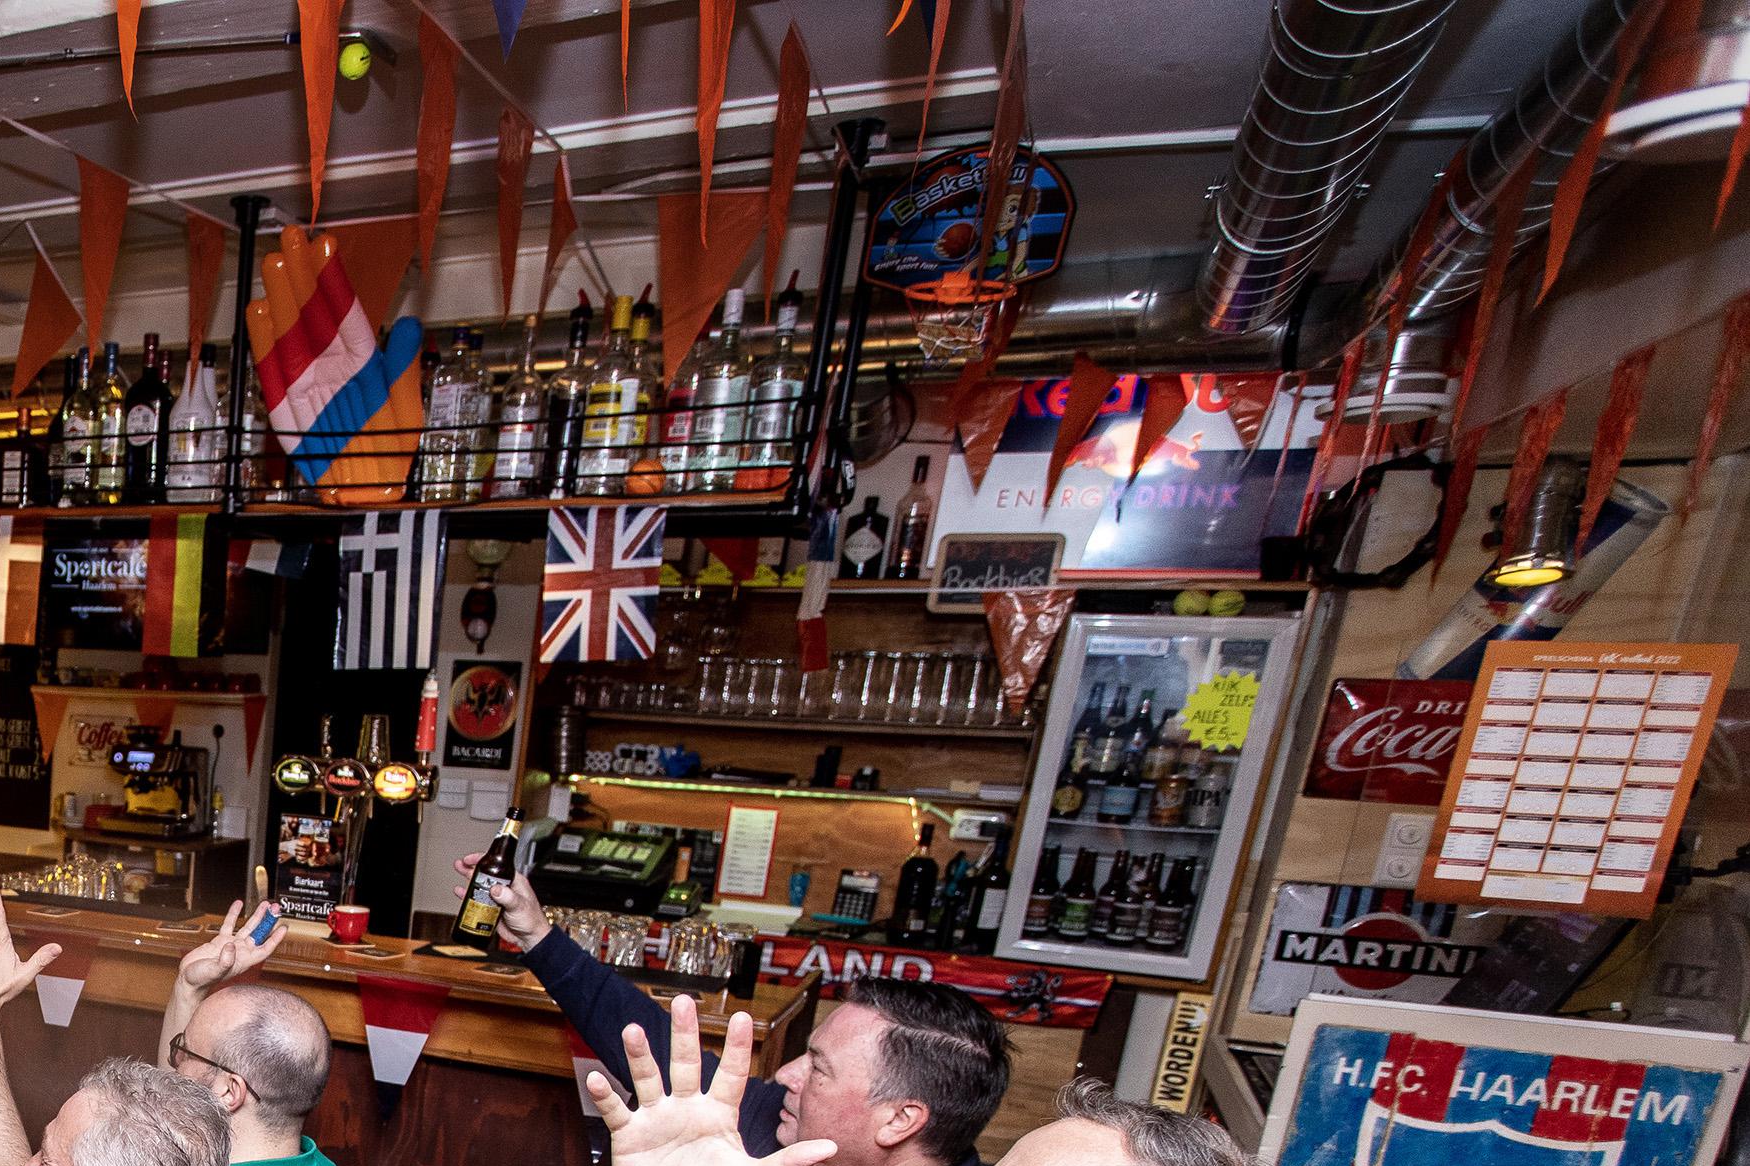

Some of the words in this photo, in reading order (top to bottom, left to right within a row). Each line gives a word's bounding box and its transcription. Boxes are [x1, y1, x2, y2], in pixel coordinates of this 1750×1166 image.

[890, 164, 1028, 226] Basketll
[53, 551, 148, 583] Sportcafé
[1654, 655, 1683, 665] 2022
[1191, 710, 1230, 724] ALLES
[1414, 700, 1467, 715] DRI
[452, 745, 503, 759] BACARDI
[1281, 933, 1478, 974] MARTINI
[1333, 1056, 1428, 1096] H.F.C.
[1450, 1069, 1690, 1126] HAARLEM
